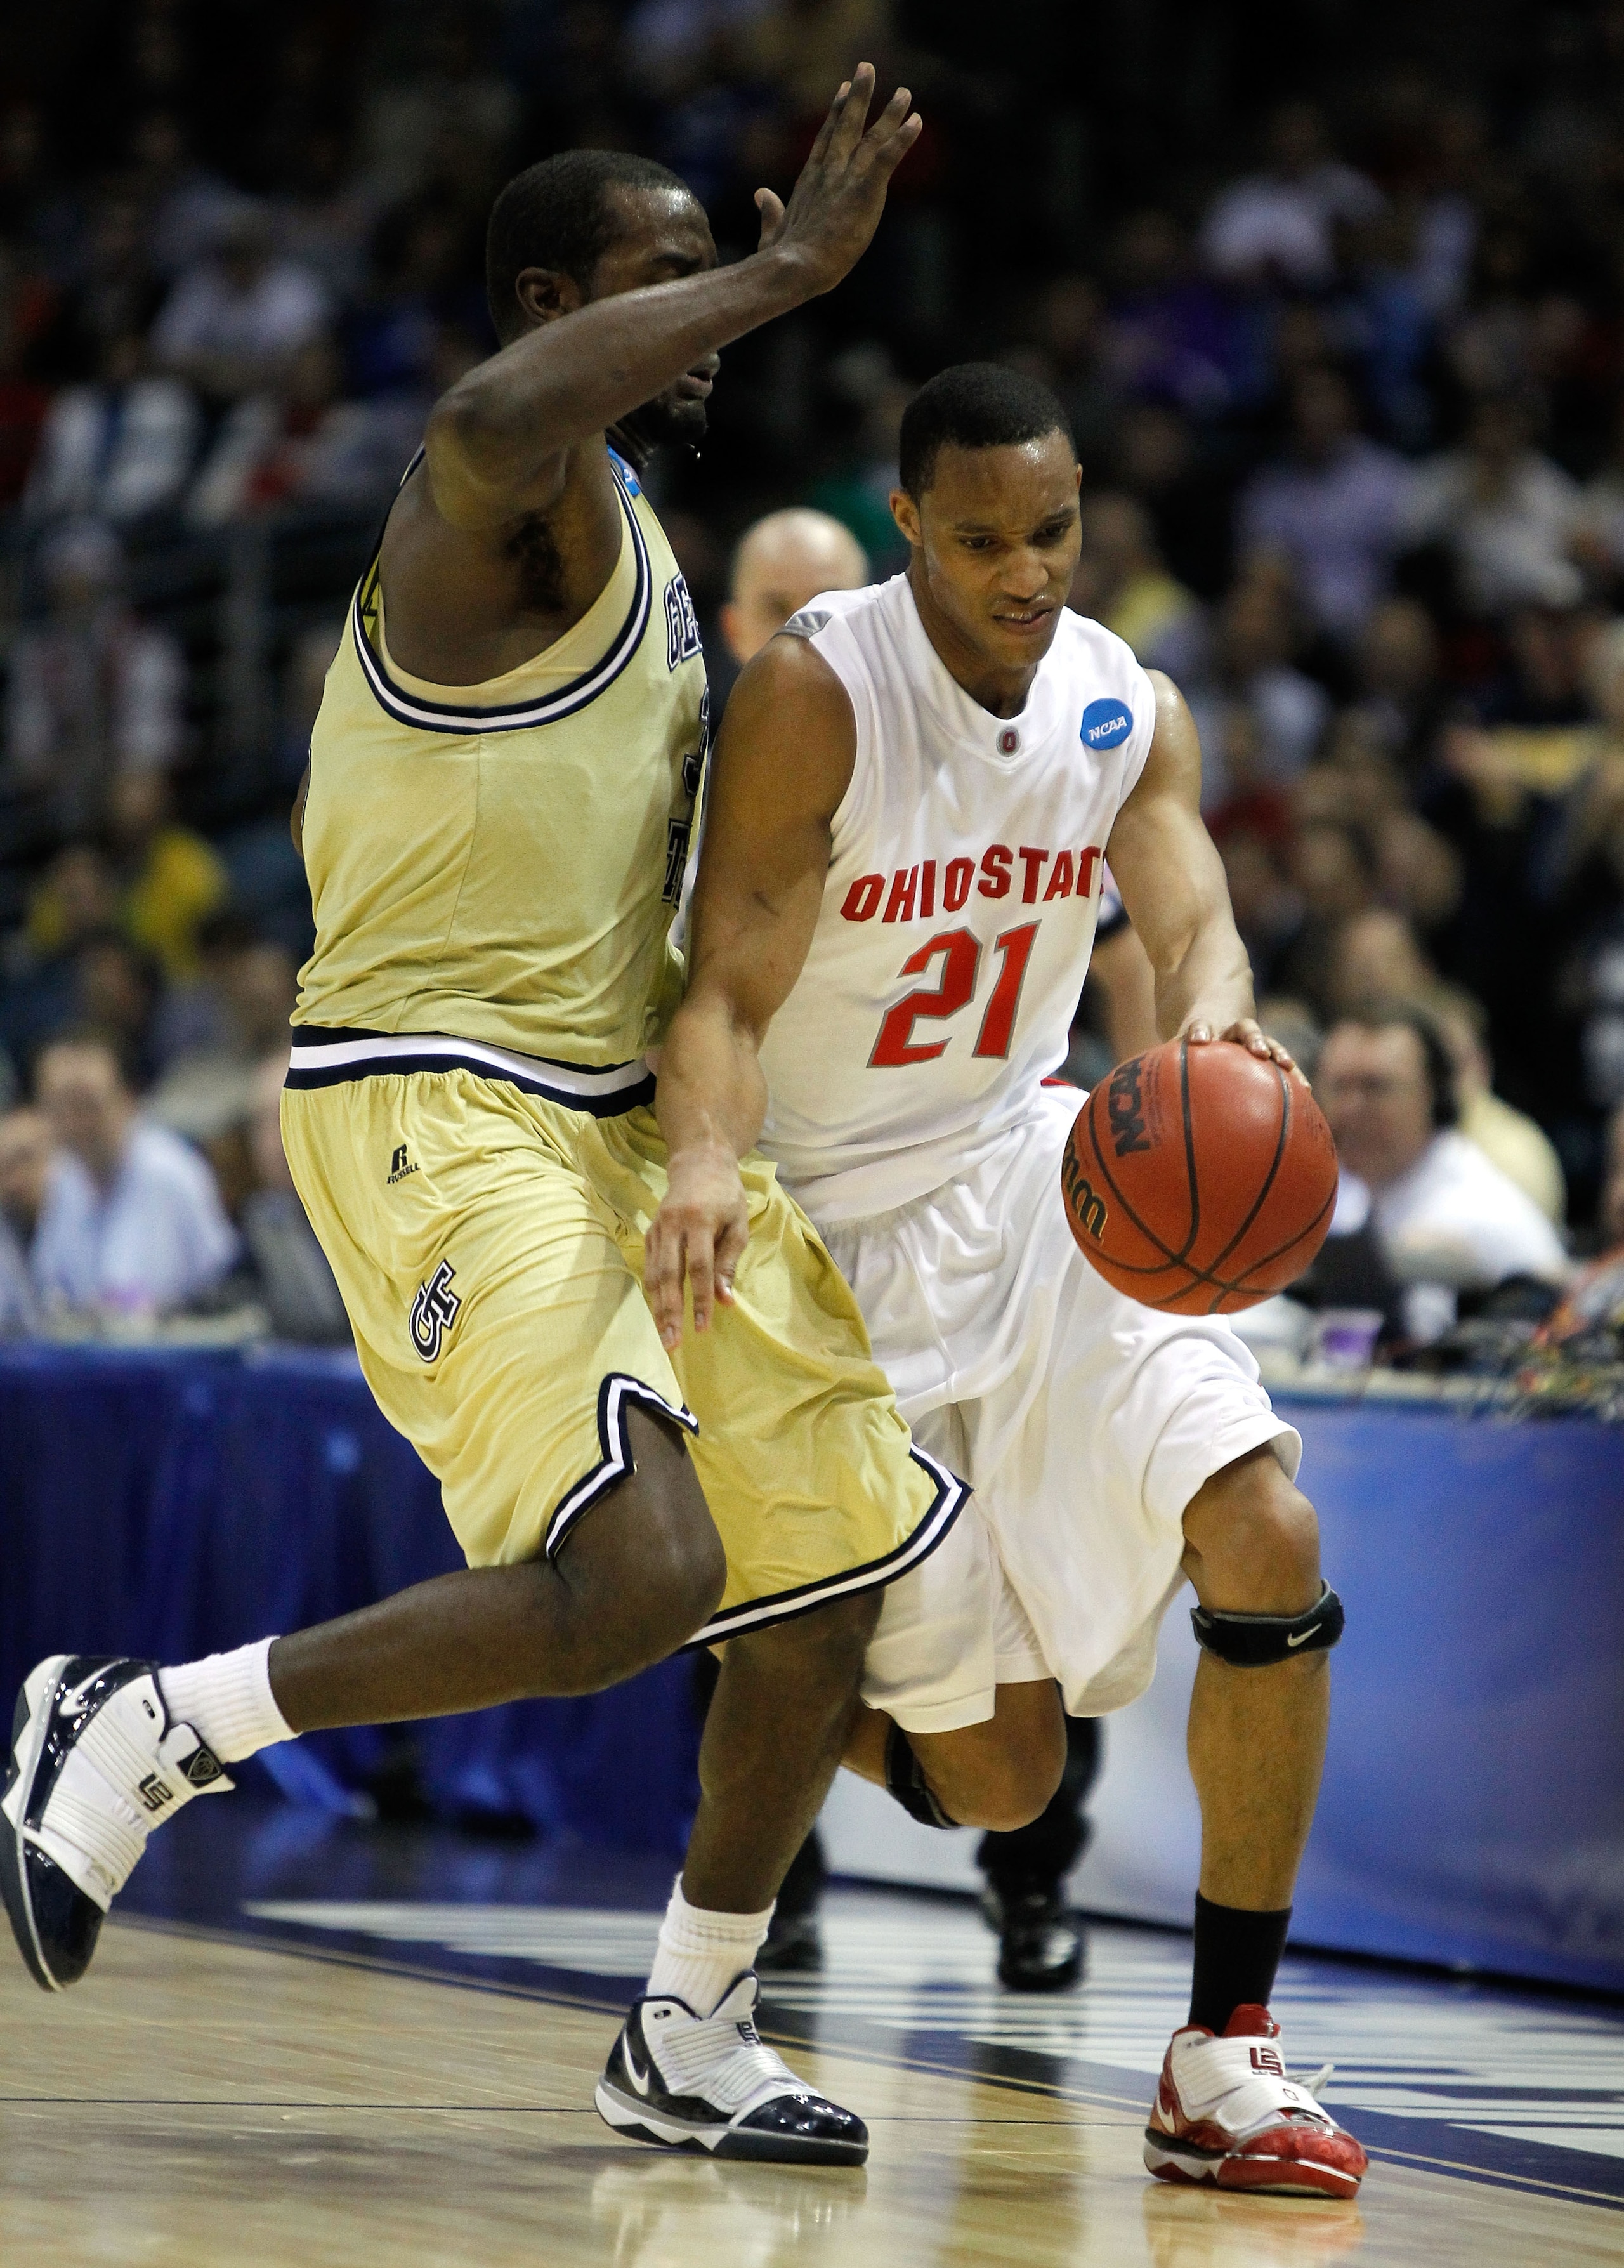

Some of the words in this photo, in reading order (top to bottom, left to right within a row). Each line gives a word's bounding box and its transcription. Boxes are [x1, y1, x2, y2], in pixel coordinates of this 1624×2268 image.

[1089, 715, 1128, 742] NCAA
[977, 844, 1106, 904] STAT
[866, 919, 1042, 1069] 21
[386, 1162, 421, 1184] RUSSELL
